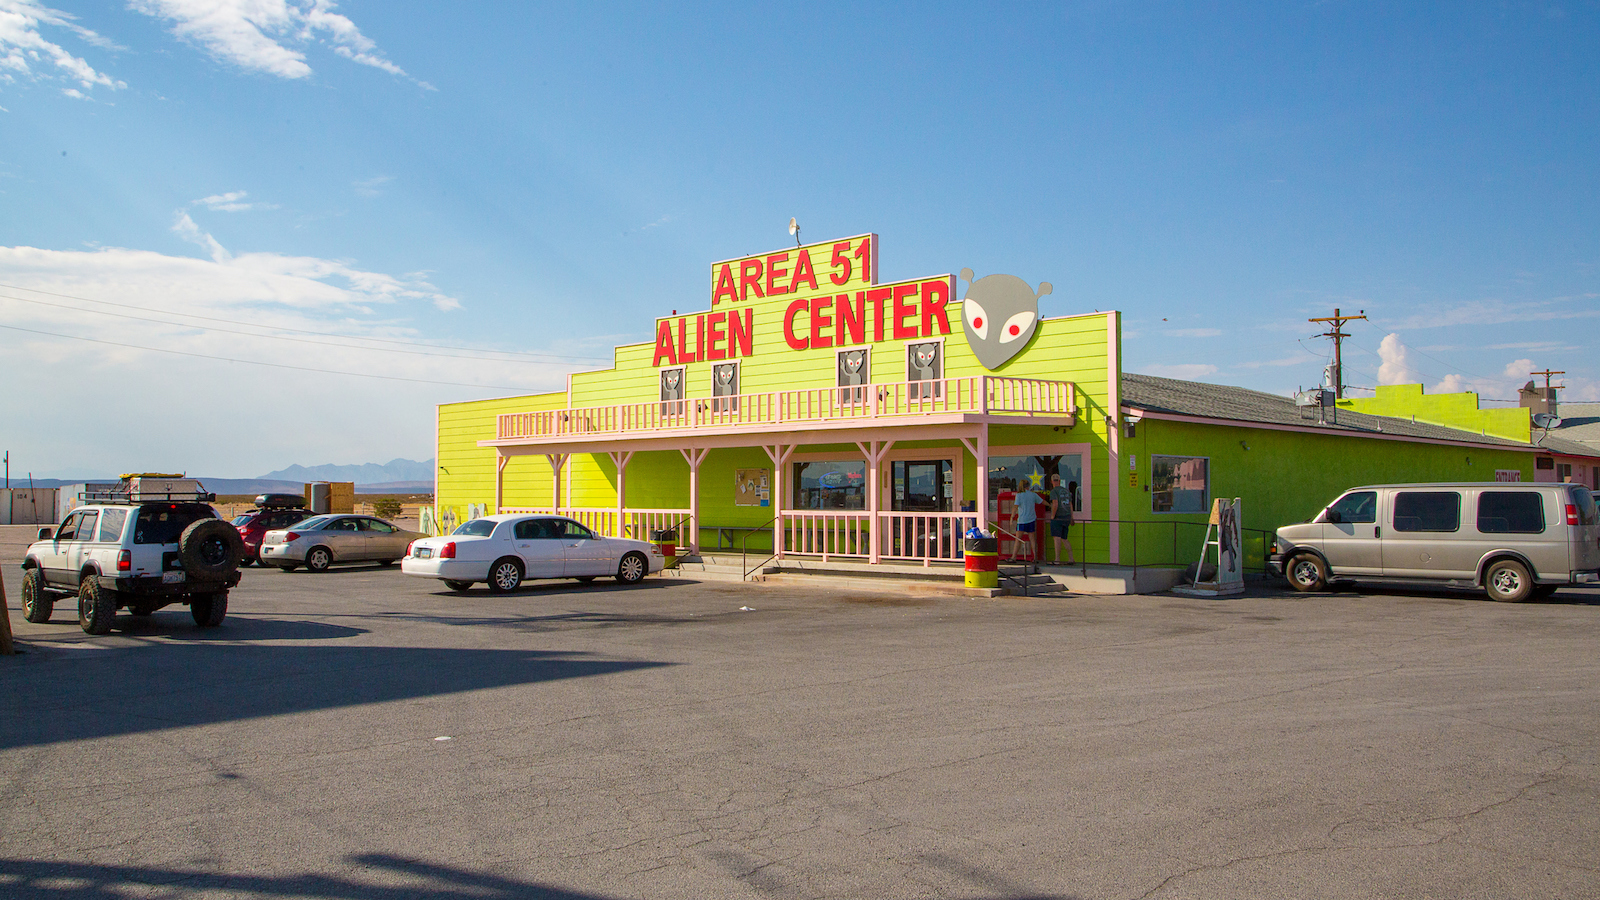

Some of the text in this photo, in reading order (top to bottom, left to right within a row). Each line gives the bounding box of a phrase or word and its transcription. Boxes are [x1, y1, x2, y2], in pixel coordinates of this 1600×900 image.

[712, 238, 871, 306] AREA 51
[652, 280, 951, 367] ALIEN CENTER
